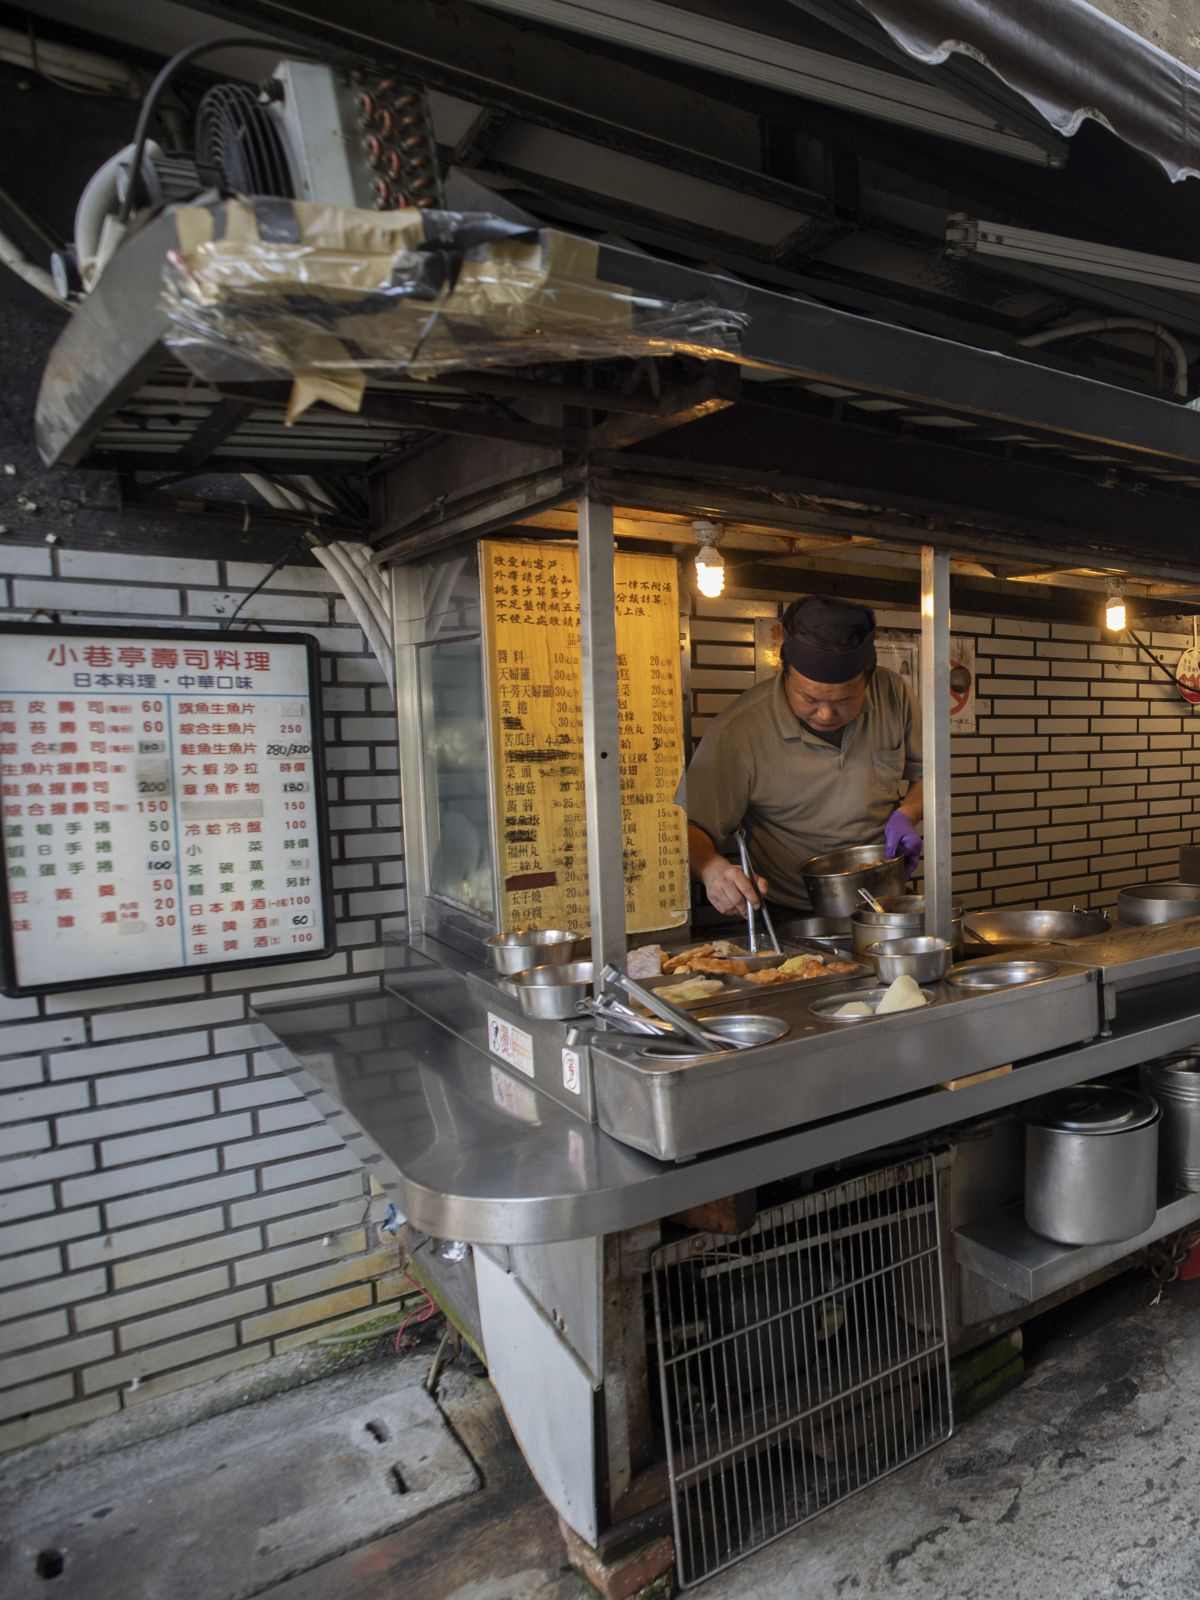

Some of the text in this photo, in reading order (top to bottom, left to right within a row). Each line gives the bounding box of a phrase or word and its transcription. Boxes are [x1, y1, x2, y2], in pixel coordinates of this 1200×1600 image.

[47, 644, 271, 672] 小巷亭壽司料理
[142, 701, 163, 712] 60
[143, 721, 164, 732] 60
[280, 724, 302, 733] 250
[181, 742, 311, 756] 鮭魚生魚片 280/320
[138, 781, 166, 793] 200
[283, 783, 304, 792] 180
[137, 801, 169, 813] 150
[284, 801, 305, 810] 150
[149, 820, 170, 832] 50
[285, 821, 306, 829] 100
[150, 840, 171, 852] 60
[508, 844, 539, 859] 福州丸
[148, 861, 172, 870] 100
[152, 879, 173, 891] 50
[188, 879, 265, 896] 關東煮
[154, 898, 175, 910] 20
[290, 896, 311, 905] 100
[155, 915, 176, 927] 30
[292, 915, 308, 925] 60
[291, 933, 313, 943] 100
